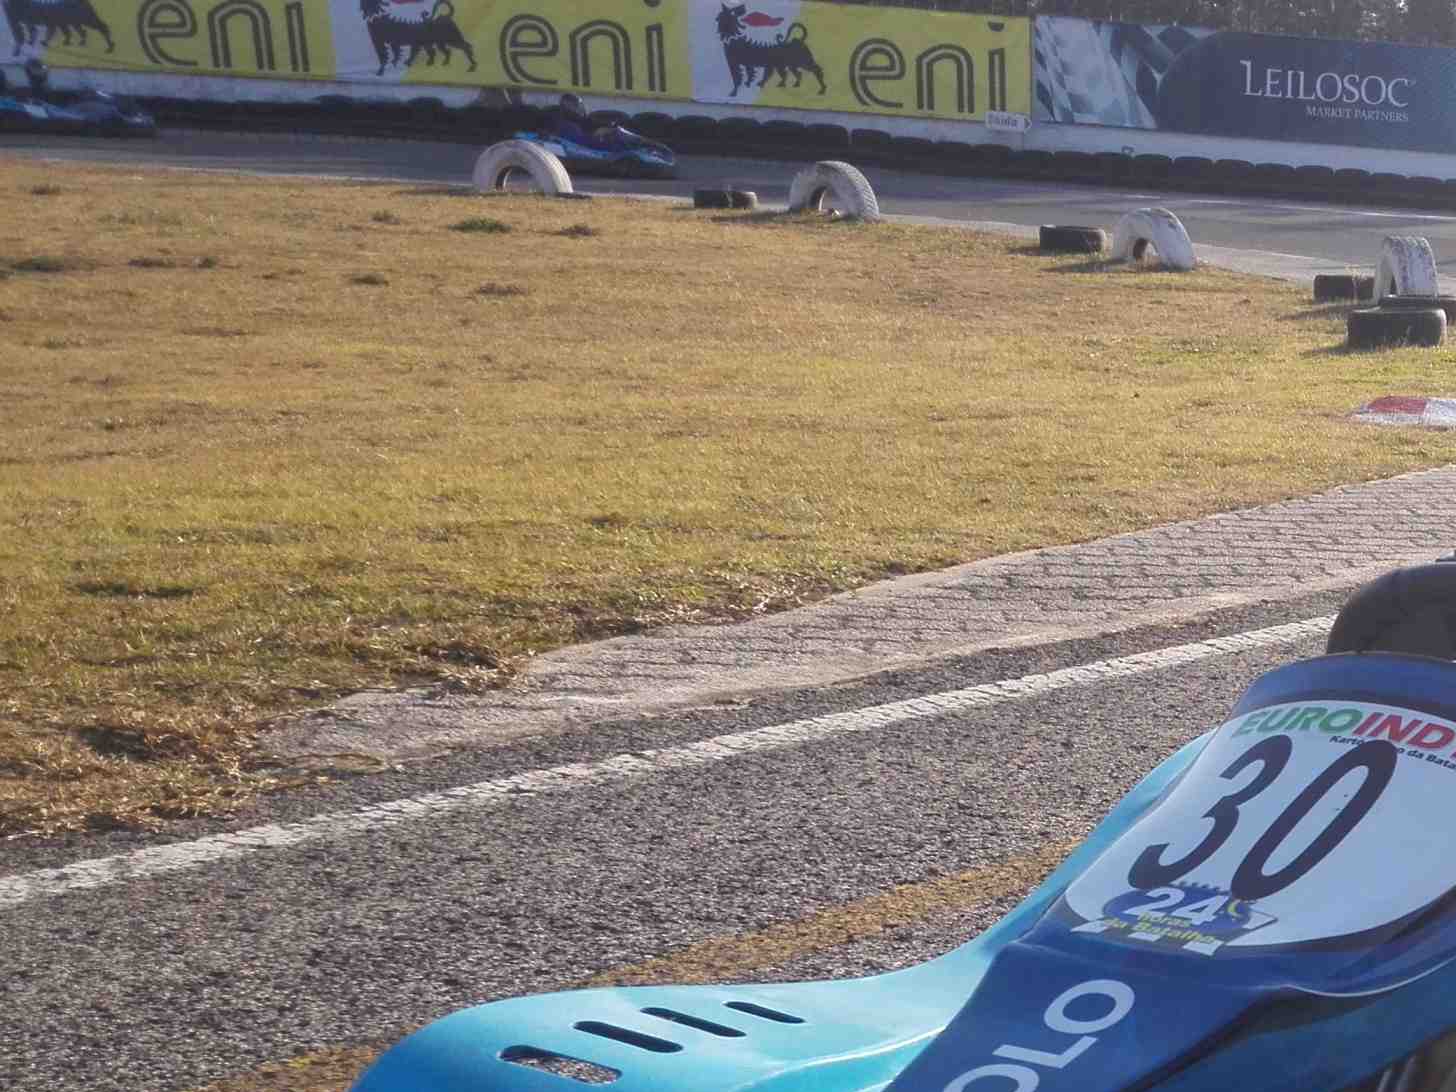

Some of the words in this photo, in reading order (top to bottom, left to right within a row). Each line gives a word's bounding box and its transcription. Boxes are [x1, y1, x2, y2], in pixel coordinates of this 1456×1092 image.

[137, 0, 310, 72] eni
[500, 0, 666, 92] eni
[849, 22, 1007, 113] eni
[1304, 105, 1352, 120] MARKET
[1354, 108, 1409, 122] PARTNERS
[1407, 749, 1424, 759] da
[1128, 734, 1397, 899] 30
[1123, 886, 1231, 926] 24
